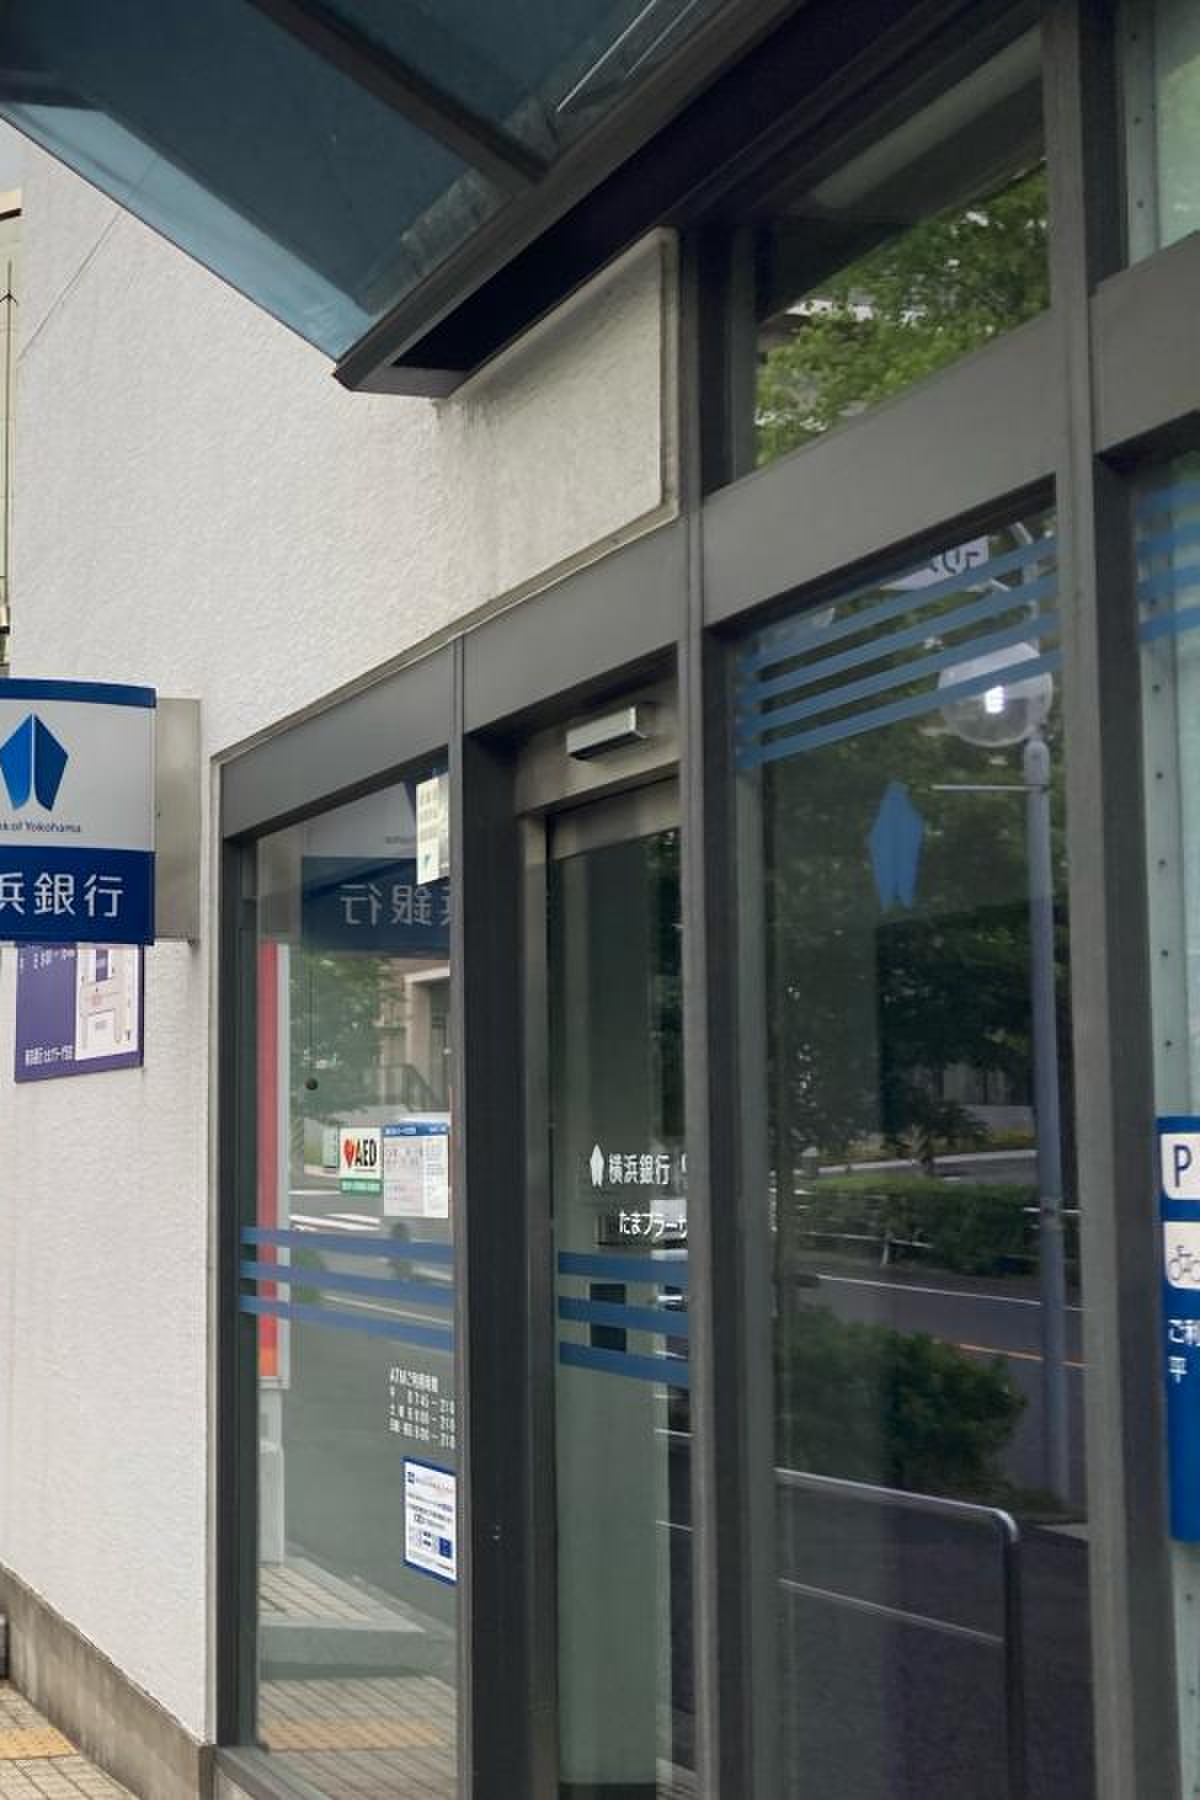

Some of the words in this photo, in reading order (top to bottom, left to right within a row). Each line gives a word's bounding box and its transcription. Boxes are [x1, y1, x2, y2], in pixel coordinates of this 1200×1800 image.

[11, 820, 23, 832] of
[24, 820, 81, 834] Yokohama
[355, 1138, 377, 1167] AED
[1173, 1145, 1192, 1188] P
[608, 1153, 670, 1184] 横浜銀行
